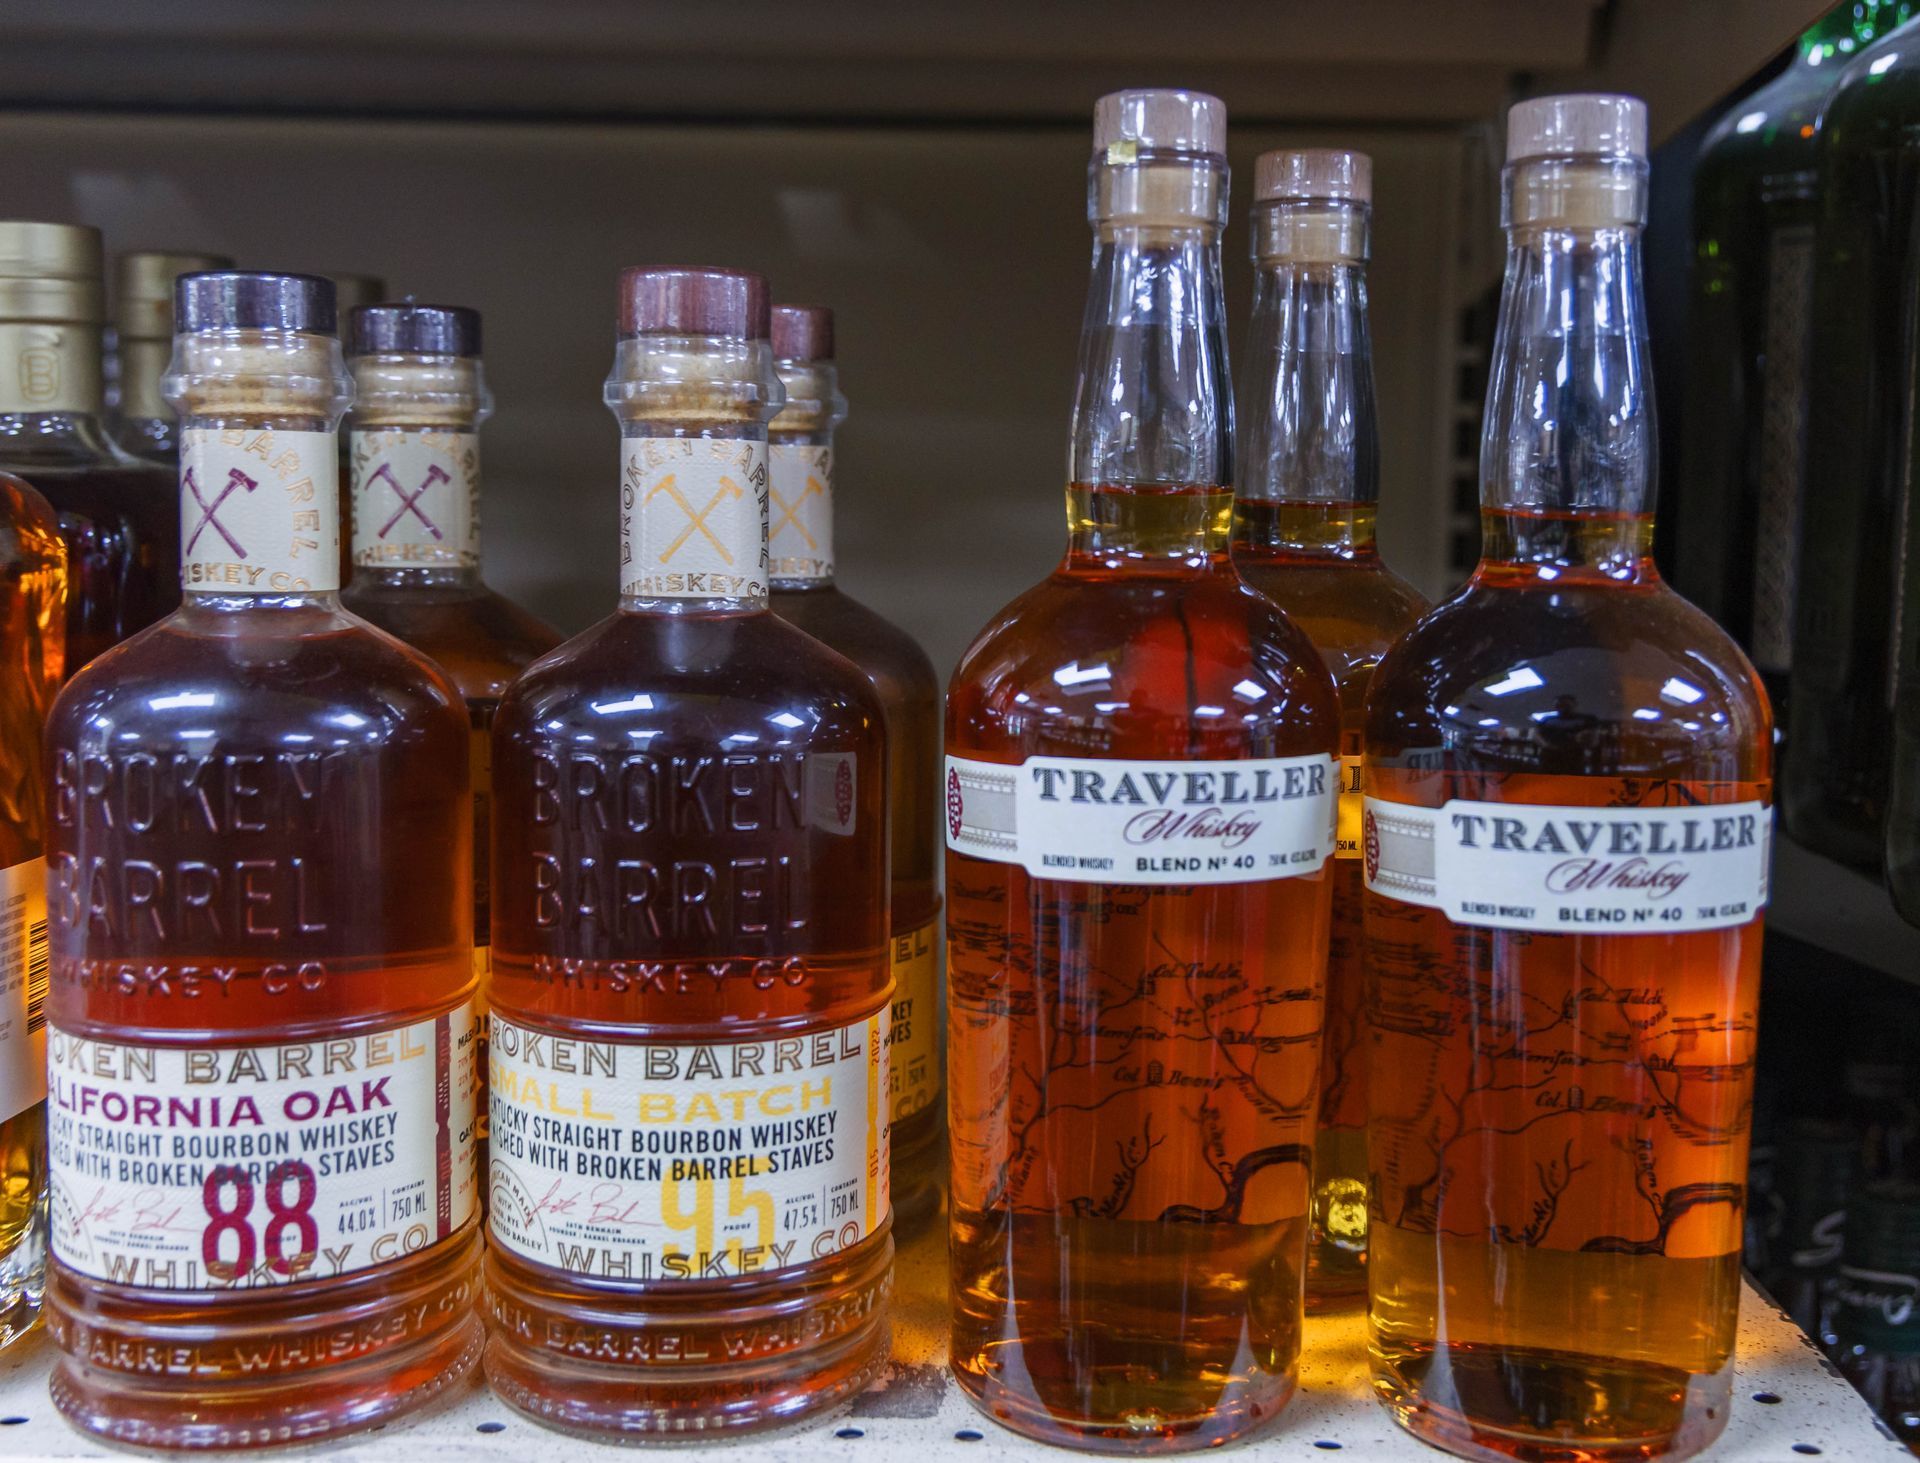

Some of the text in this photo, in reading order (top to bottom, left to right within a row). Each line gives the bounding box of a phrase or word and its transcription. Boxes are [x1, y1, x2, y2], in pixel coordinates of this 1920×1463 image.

[56, 748, 324, 833] BROKEN
[532, 748, 808, 834] BROKEN
[1033, 763, 1326, 805] TRAVELLER
[1122, 807, 1263, 850] Whiskey
[1452, 814, 1756, 855] TRAVELLER
[1136, 856, 1202, 872] BLEND
[1232, 855, 1256, 869] 40
[1545, 856, 1691, 900] Whiskey
[57, 851, 327, 940] BARREL
[532, 851, 808, 940] BARREL
[1558, 906, 1627, 923] BLEND
[1659, 906, 1683, 922] 40
[261, 960, 327, 996] CO
[533, 953, 809, 995] WHISKEY CO
[185, 1027, 427, 1084] BARREL
[490, 1017, 617, 1078] ROKEN
[643, 1027, 861, 1081] BARREL
[282, 1075, 393, 1122] OAK
[489, 1054, 617, 1121] SMALL
[638, 1075, 833, 1124] BATCH
[78, 1122, 163, 1158] STRAIGHT
[173, 1129, 290, 1158] BOURBON
[299, 1111, 398, 1152] WHISKEY
[533, 1115, 623, 1152] STRAIGHT
[631, 1127, 742, 1155] BOURBON
[751, 1109, 838, 1148] WHISKEY
[75, 1150, 111, 1180] WITH
[118, 1159, 204, 1187] BROKEN
[214, 1157, 310, 1187] BARREL
[318, 1140, 395, 1177] STAVES
[528, 1139, 569, 1173] WITH
[576, 1151, 662, 1181] BROKEN
[671, 1153, 760, 1182] BARREL
[767, 1138, 835, 1174] STAVES
[202, 1159, 320, 1281] 88
[338, 1205, 376, 1235] 44.0%
[392, 1199, 412, 1222] 750
[414, 1191, 428, 1212] ML
[660, 1156, 776, 1273] 95
[722, 1221, 752, 1232] PROOF
[783, 1188, 859, 1232] 47.5% 750 ML
[370, 1222, 429, 1265] CO
[512, 1232, 543, 1252] BARLEY
[557, 1220, 860, 1282] WHISKEY CO
[76, 1332, 223, 1375] BARREL
[234, 1303, 430, 1372] WHISKEY
[546, 1318, 709, 1361] BARREL
